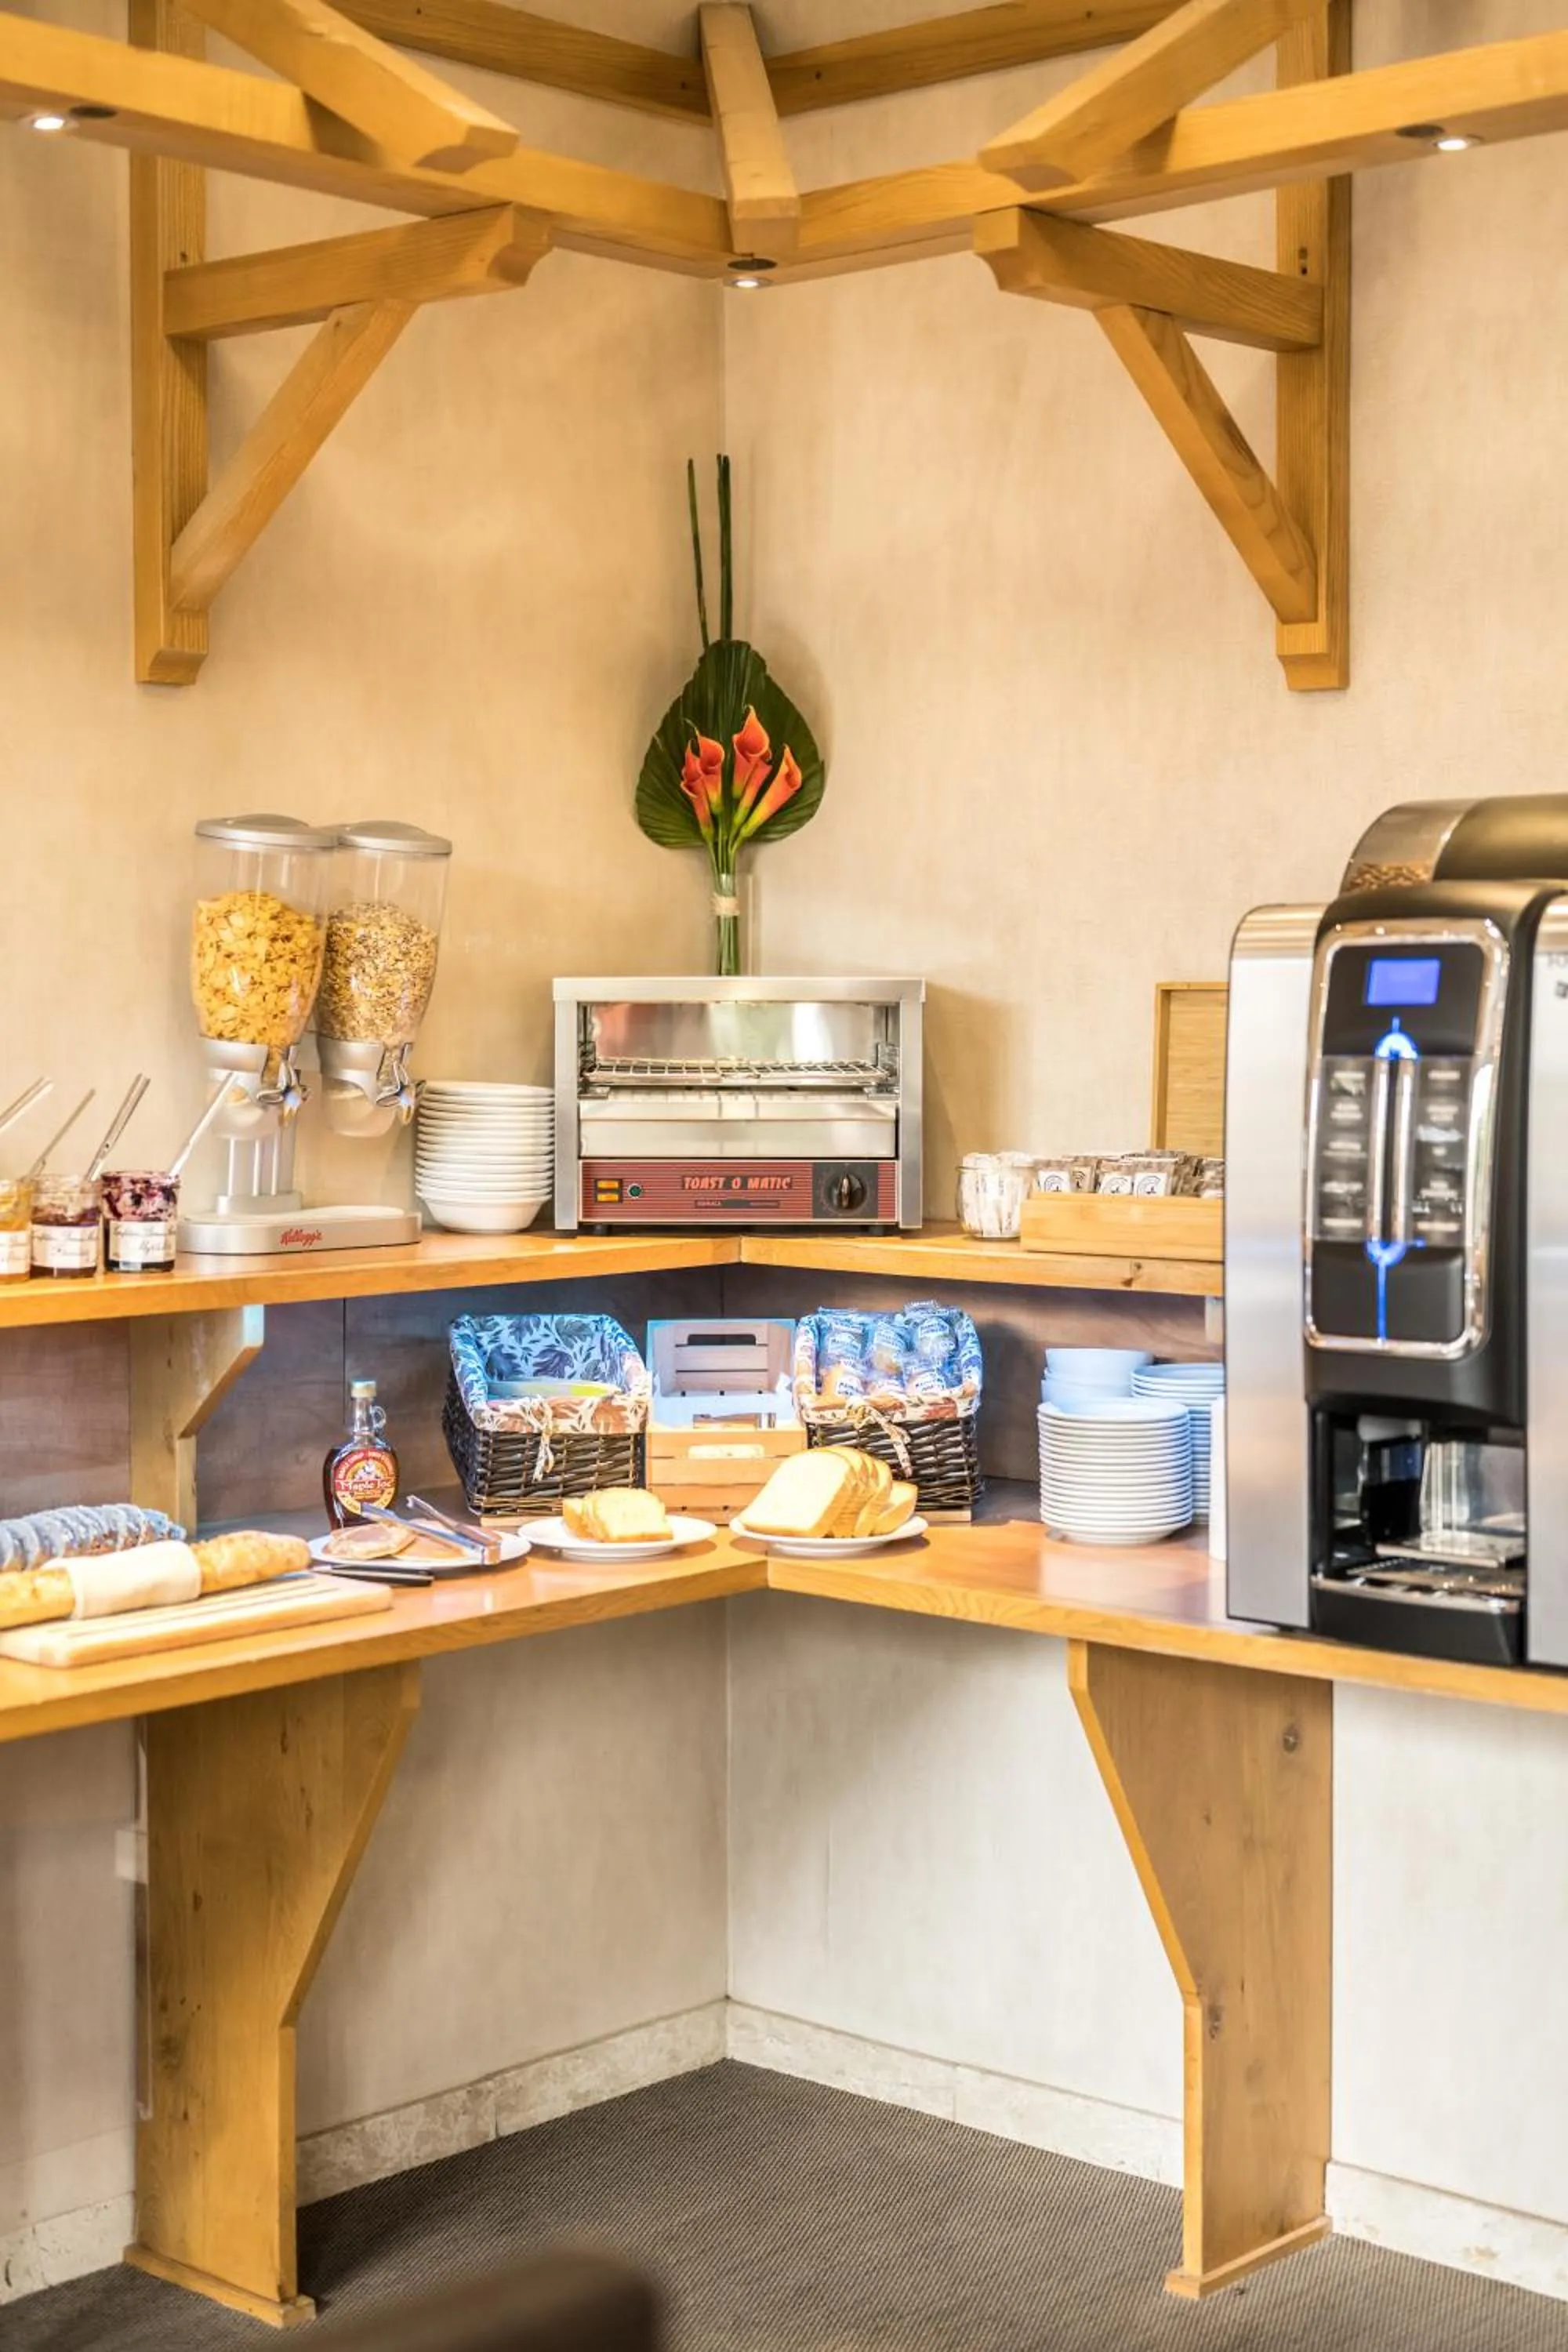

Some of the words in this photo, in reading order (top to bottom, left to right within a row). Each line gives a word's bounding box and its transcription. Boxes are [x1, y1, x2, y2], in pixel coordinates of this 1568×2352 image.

[684, 1177, 725, 1189] TOAST
[731, 1177, 741, 1189] O
[747, 1177, 791, 1189] MATIC
[280, 1229, 322, 1247] Kellogg's
